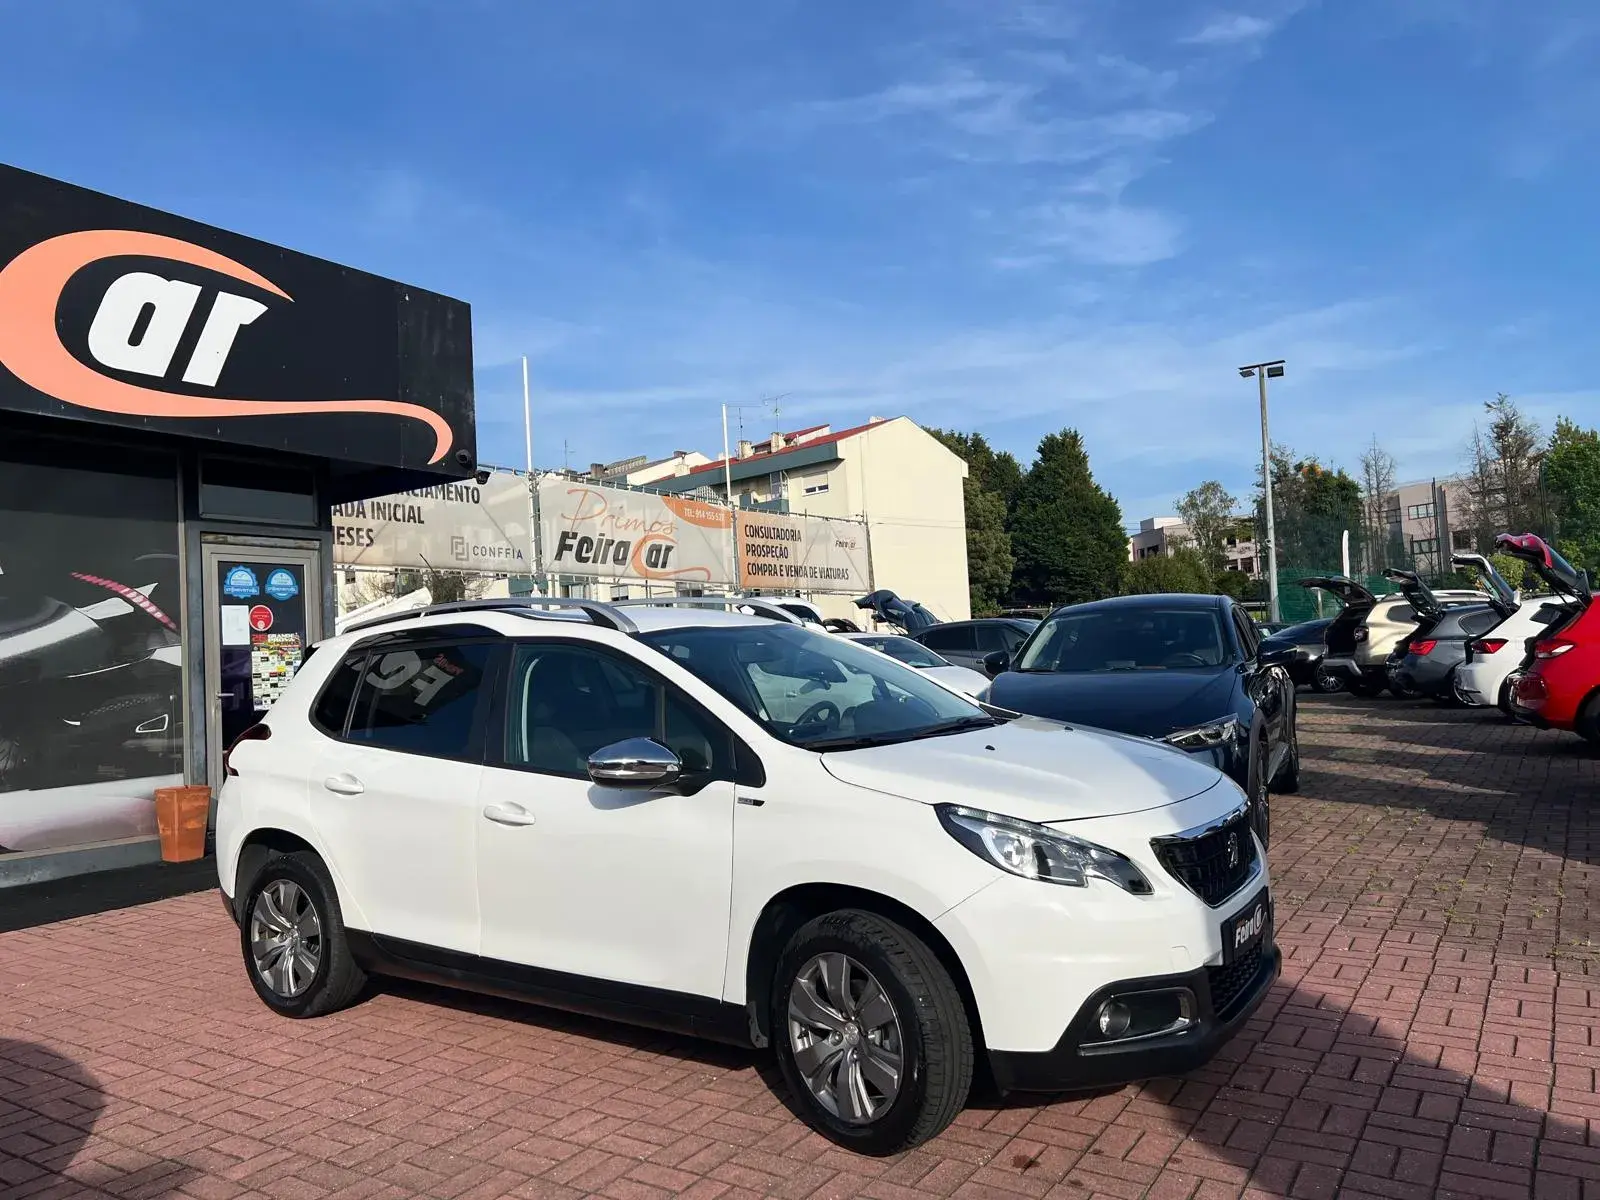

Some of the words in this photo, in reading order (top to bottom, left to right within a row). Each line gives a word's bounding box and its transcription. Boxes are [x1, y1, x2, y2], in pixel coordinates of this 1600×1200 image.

[371, 501, 425, 524] INICIAL
[561, 488, 679, 537] Primos
[332, 525, 374, 547] ESES
[744, 524, 802, 542] CONSULTADORIA
[472, 545, 523, 559] CONFFIA
[745, 543, 789, 561] PROSPEÇÃO
[747, 562, 779, 577] COMPRA
[780, 564, 784, 577] E
[785, 564, 808, 579] VENDA
[809, 566, 818, 579] DE
[819, 566, 849, 581] VIATURAS
